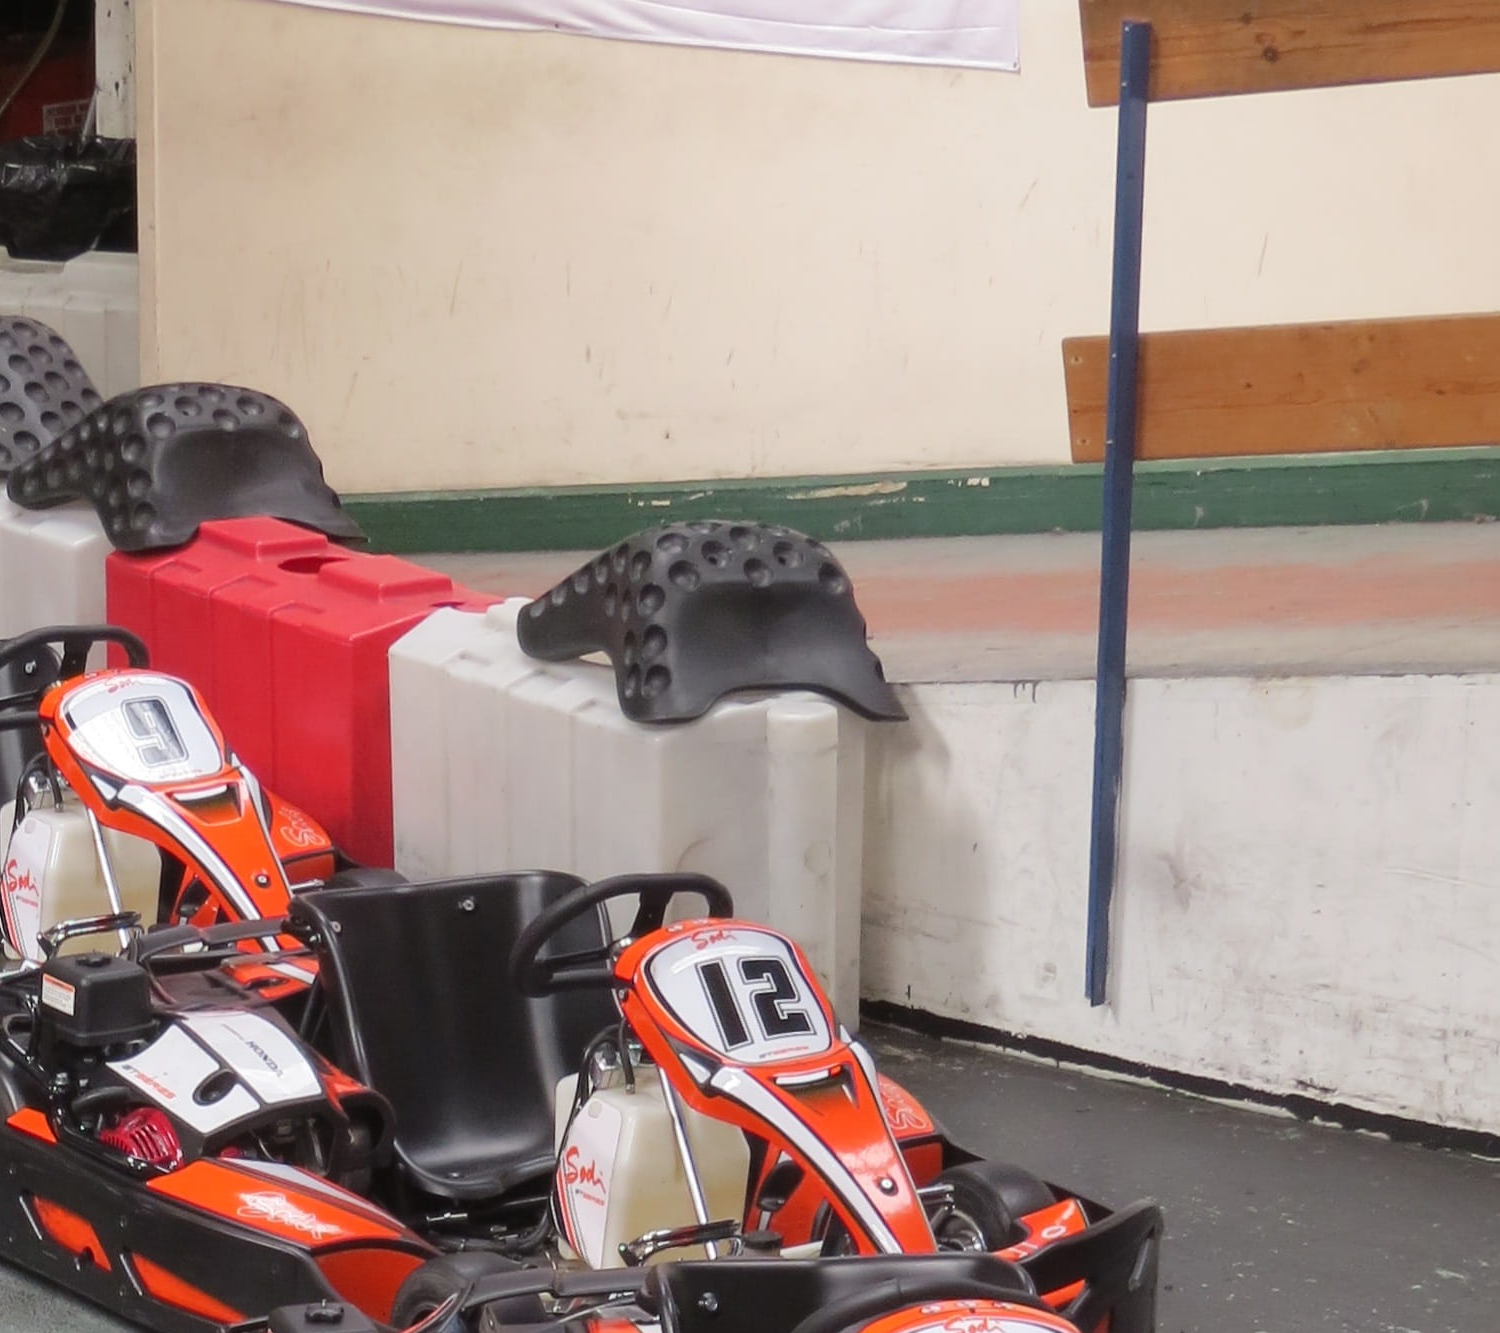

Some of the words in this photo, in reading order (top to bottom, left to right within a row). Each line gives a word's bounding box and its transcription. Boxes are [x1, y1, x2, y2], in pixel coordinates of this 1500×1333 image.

[121, 696, 189, 768] 9
[691, 929, 738, 951] Sodi
[696, 956, 818, 1052] 12
[245, 1039, 284, 1078] HONDA
[563, 1145, 607, 1194] Sodi
